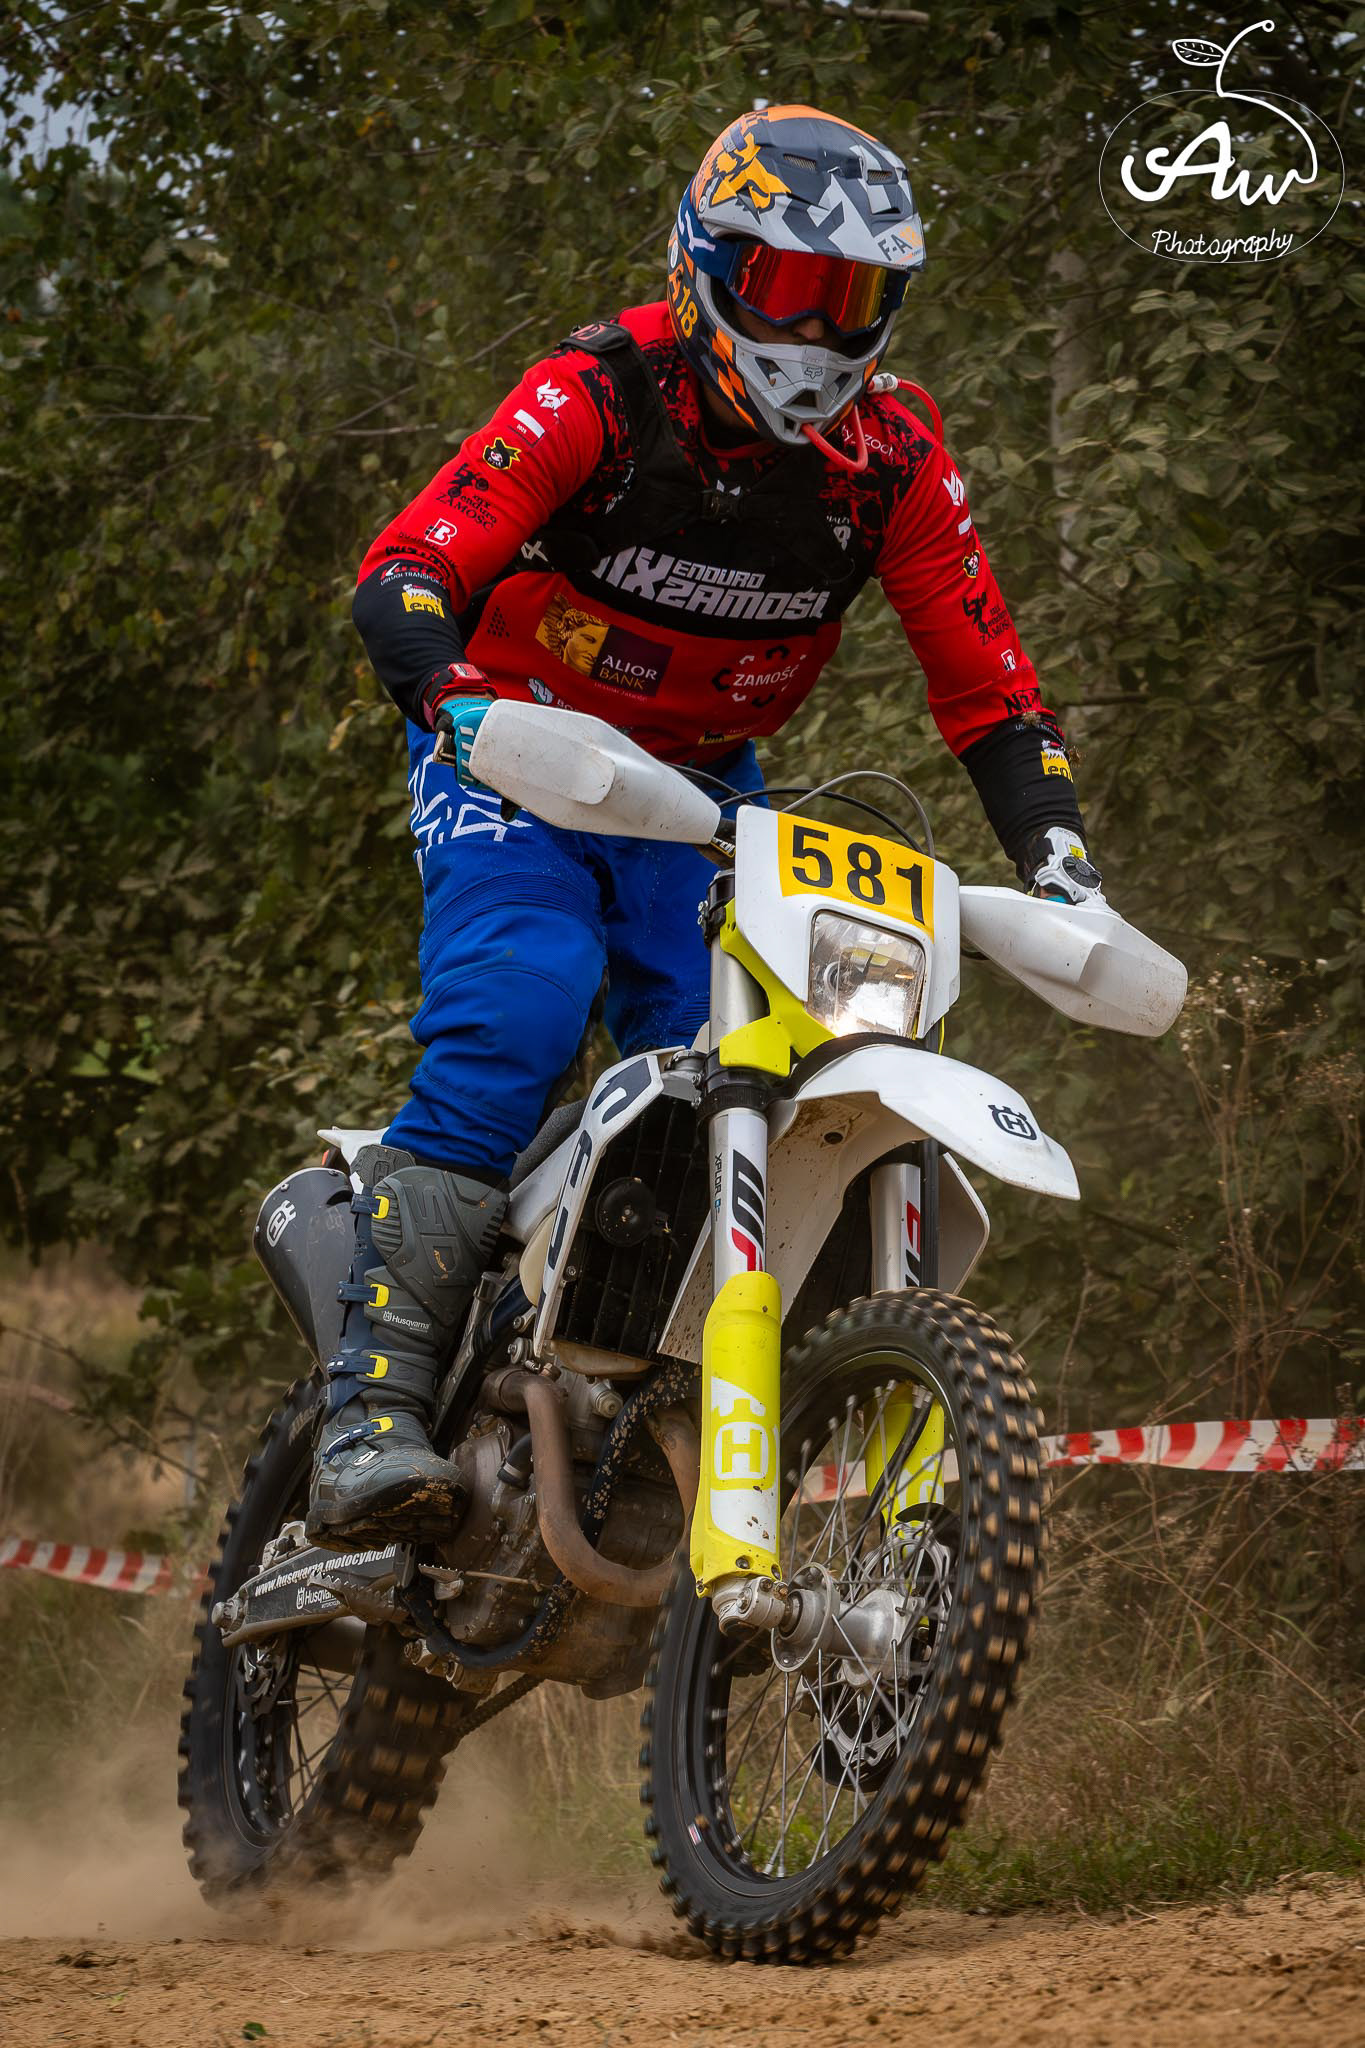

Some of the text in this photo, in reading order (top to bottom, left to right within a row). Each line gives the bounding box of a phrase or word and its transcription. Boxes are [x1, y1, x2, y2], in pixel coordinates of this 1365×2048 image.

[671, 560, 766, 589] ENDURO
[599, 667, 645, 690] BANK
[602, 654, 658, 681] ALIOR
[792, 824, 926, 926] 581
[392, 1314, 430, 1330] Husqvarna
[304, 1588, 336, 1606] Husqvar
